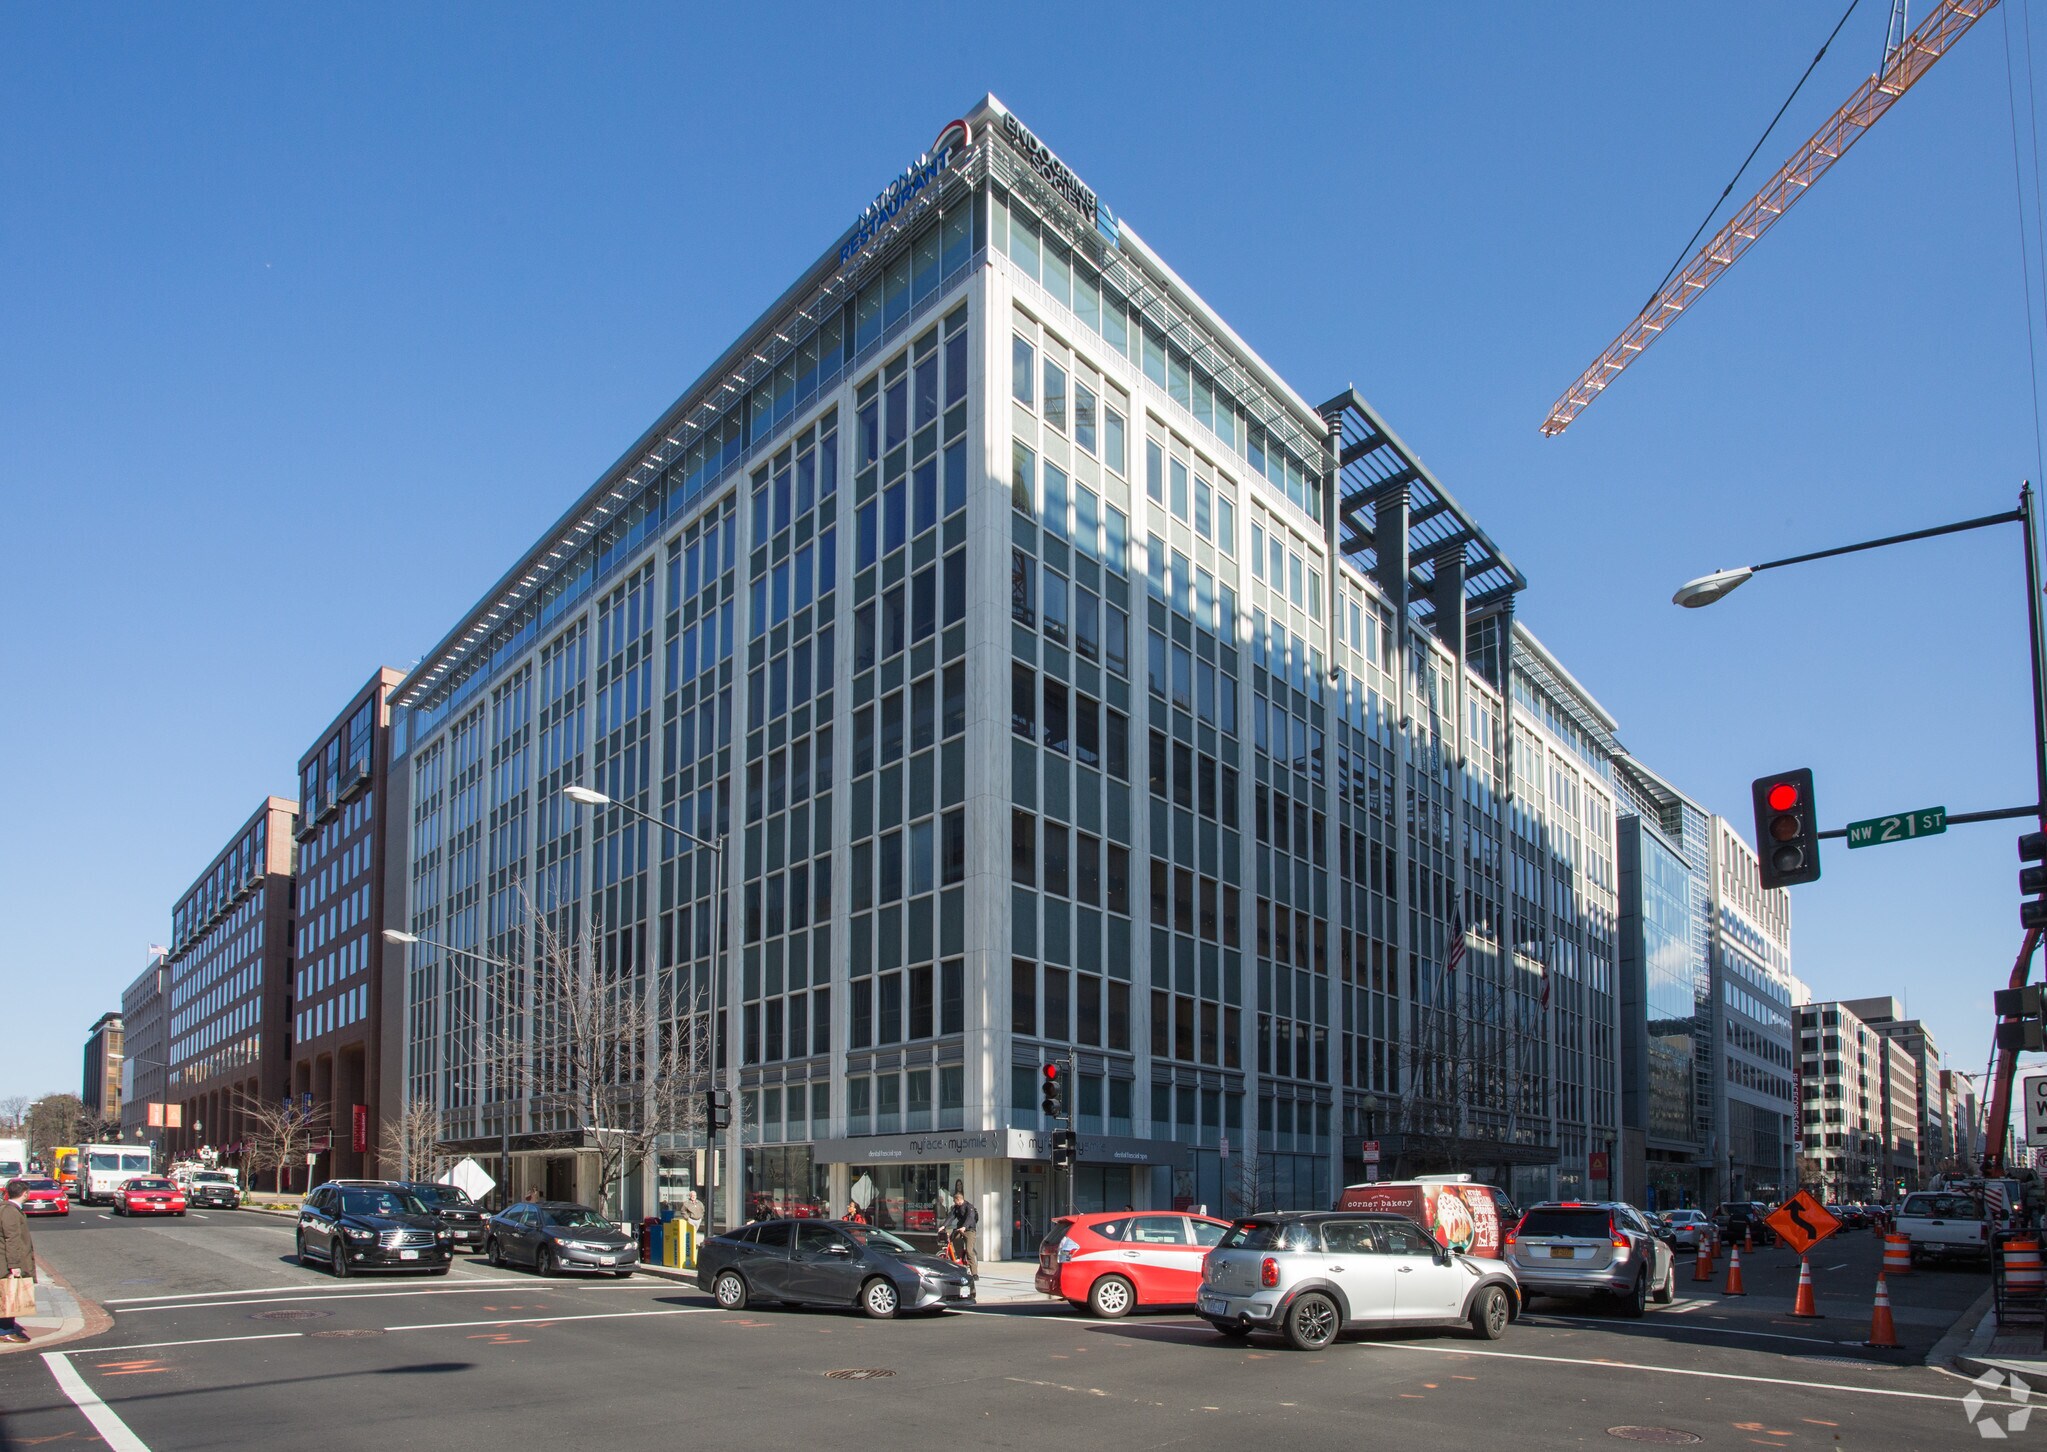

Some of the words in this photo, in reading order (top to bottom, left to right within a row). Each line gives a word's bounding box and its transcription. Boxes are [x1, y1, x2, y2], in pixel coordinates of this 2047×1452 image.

[1004, 111, 1097, 206] ENDOCRINE
[1031, 154, 1096, 222] SOCIETY
[840, 146, 952, 266] RESTAURANT
[1850, 826, 1872, 841] NW
[1880, 814, 1916, 841] 21
[1923, 813, 1943, 829] ST
[1792, 1073, 1800, 1136] PEACECORPS.GOV
[909, 1137, 942, 1154] myface
[948, 1134, 987, 1153] mysmile
[1381, 1200, 1413, 1208] bakery
